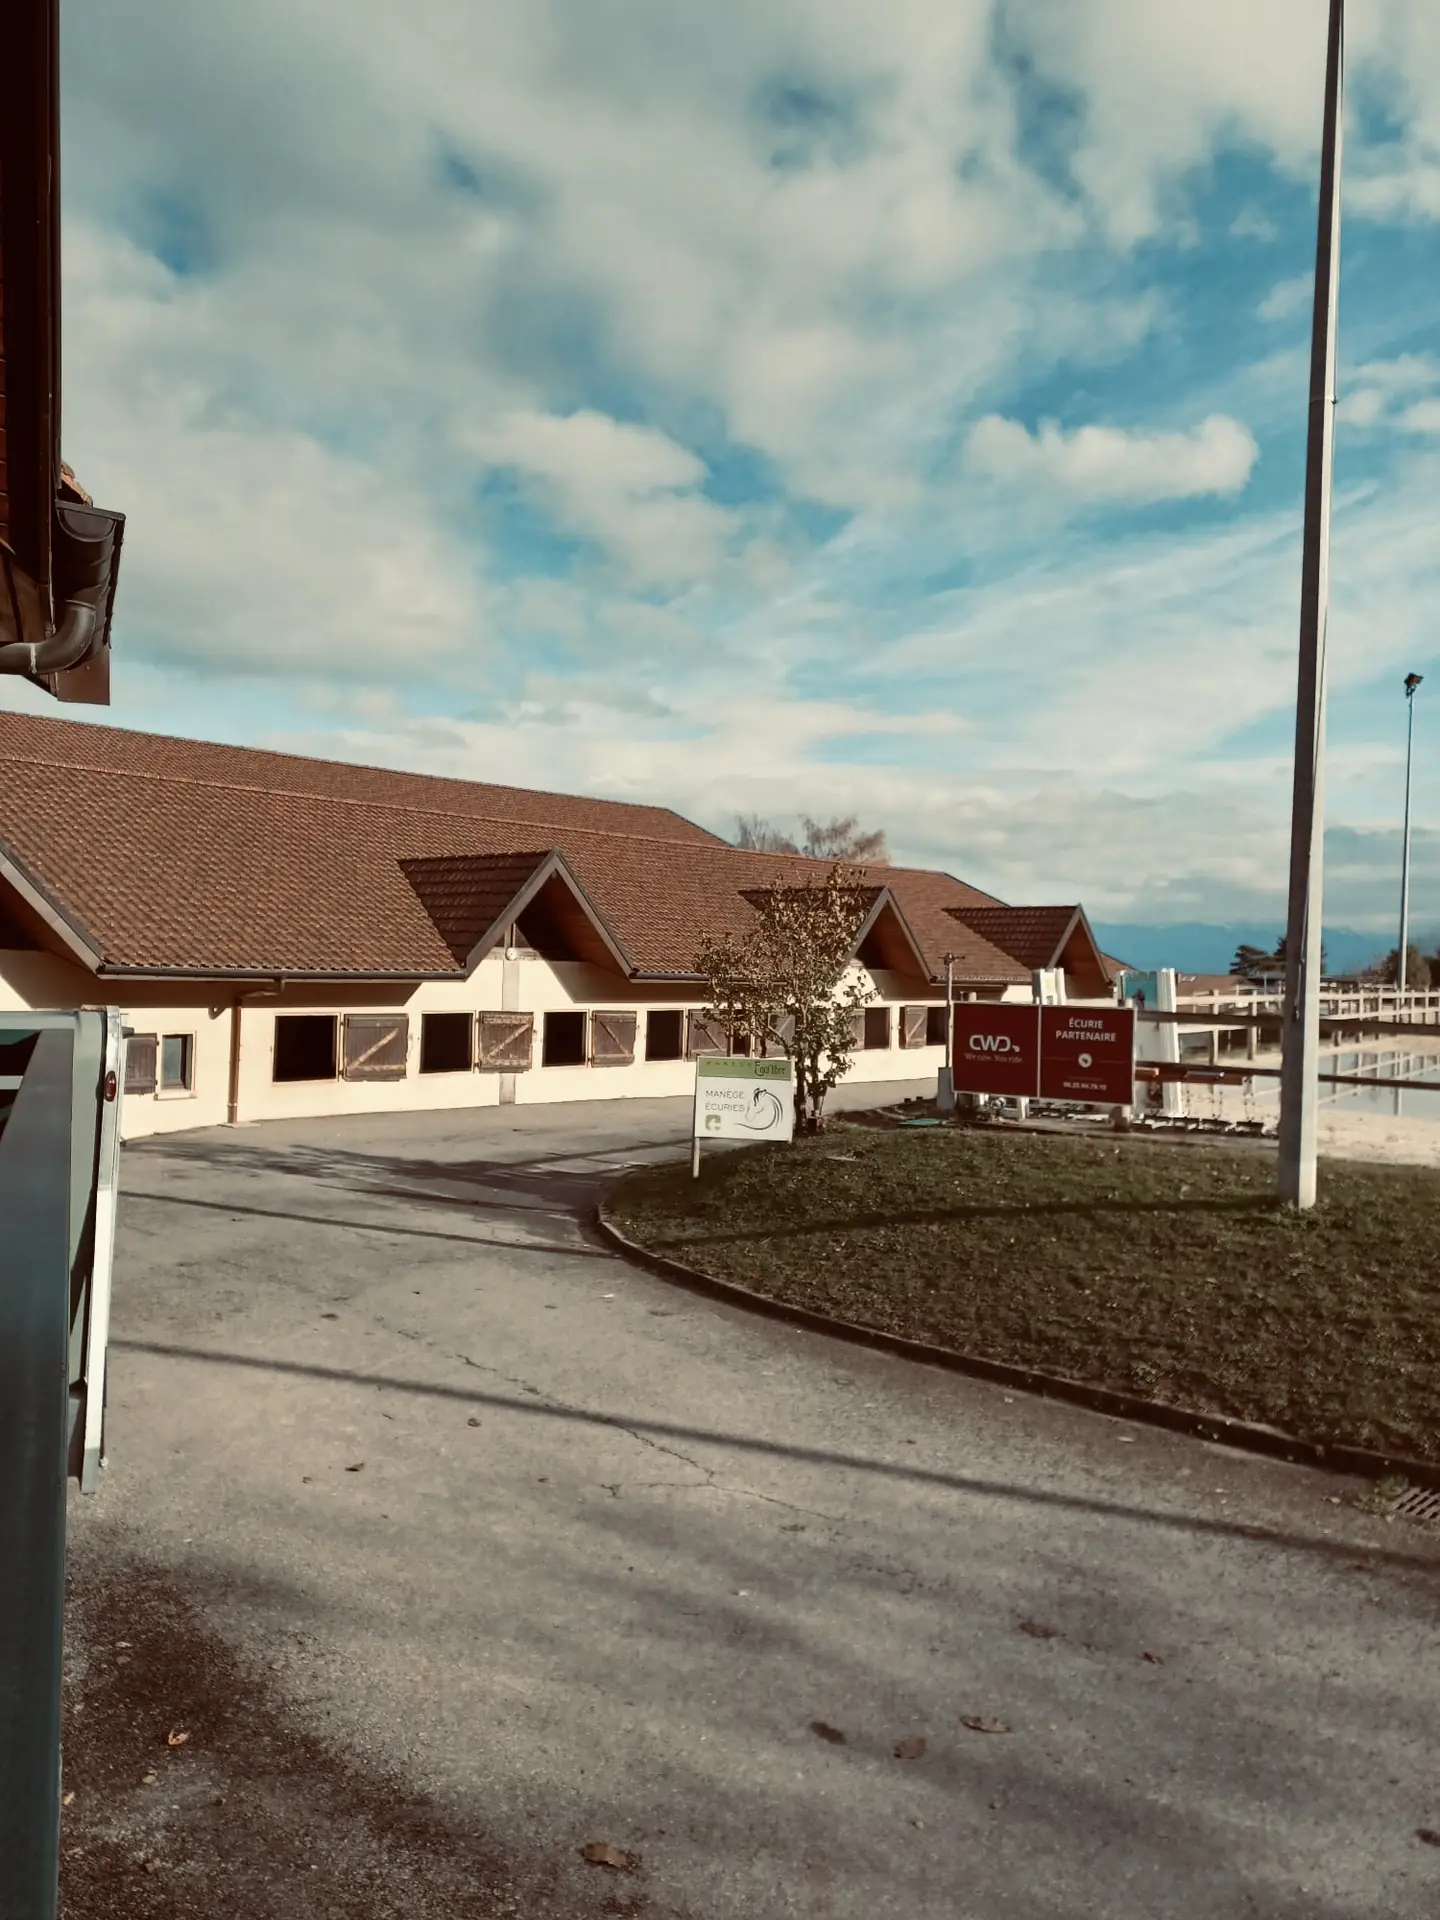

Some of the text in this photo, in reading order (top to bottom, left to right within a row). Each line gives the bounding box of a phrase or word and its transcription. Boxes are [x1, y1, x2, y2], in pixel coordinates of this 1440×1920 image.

[1069, 1016, 1104, 1029] ÉCURIE
[1055, 1029, 1117, 1042] PARTENAIRE
[969, 1034, 1011, 1052] CWD
[705, 1101, 745, 1112] ÉCURIES
